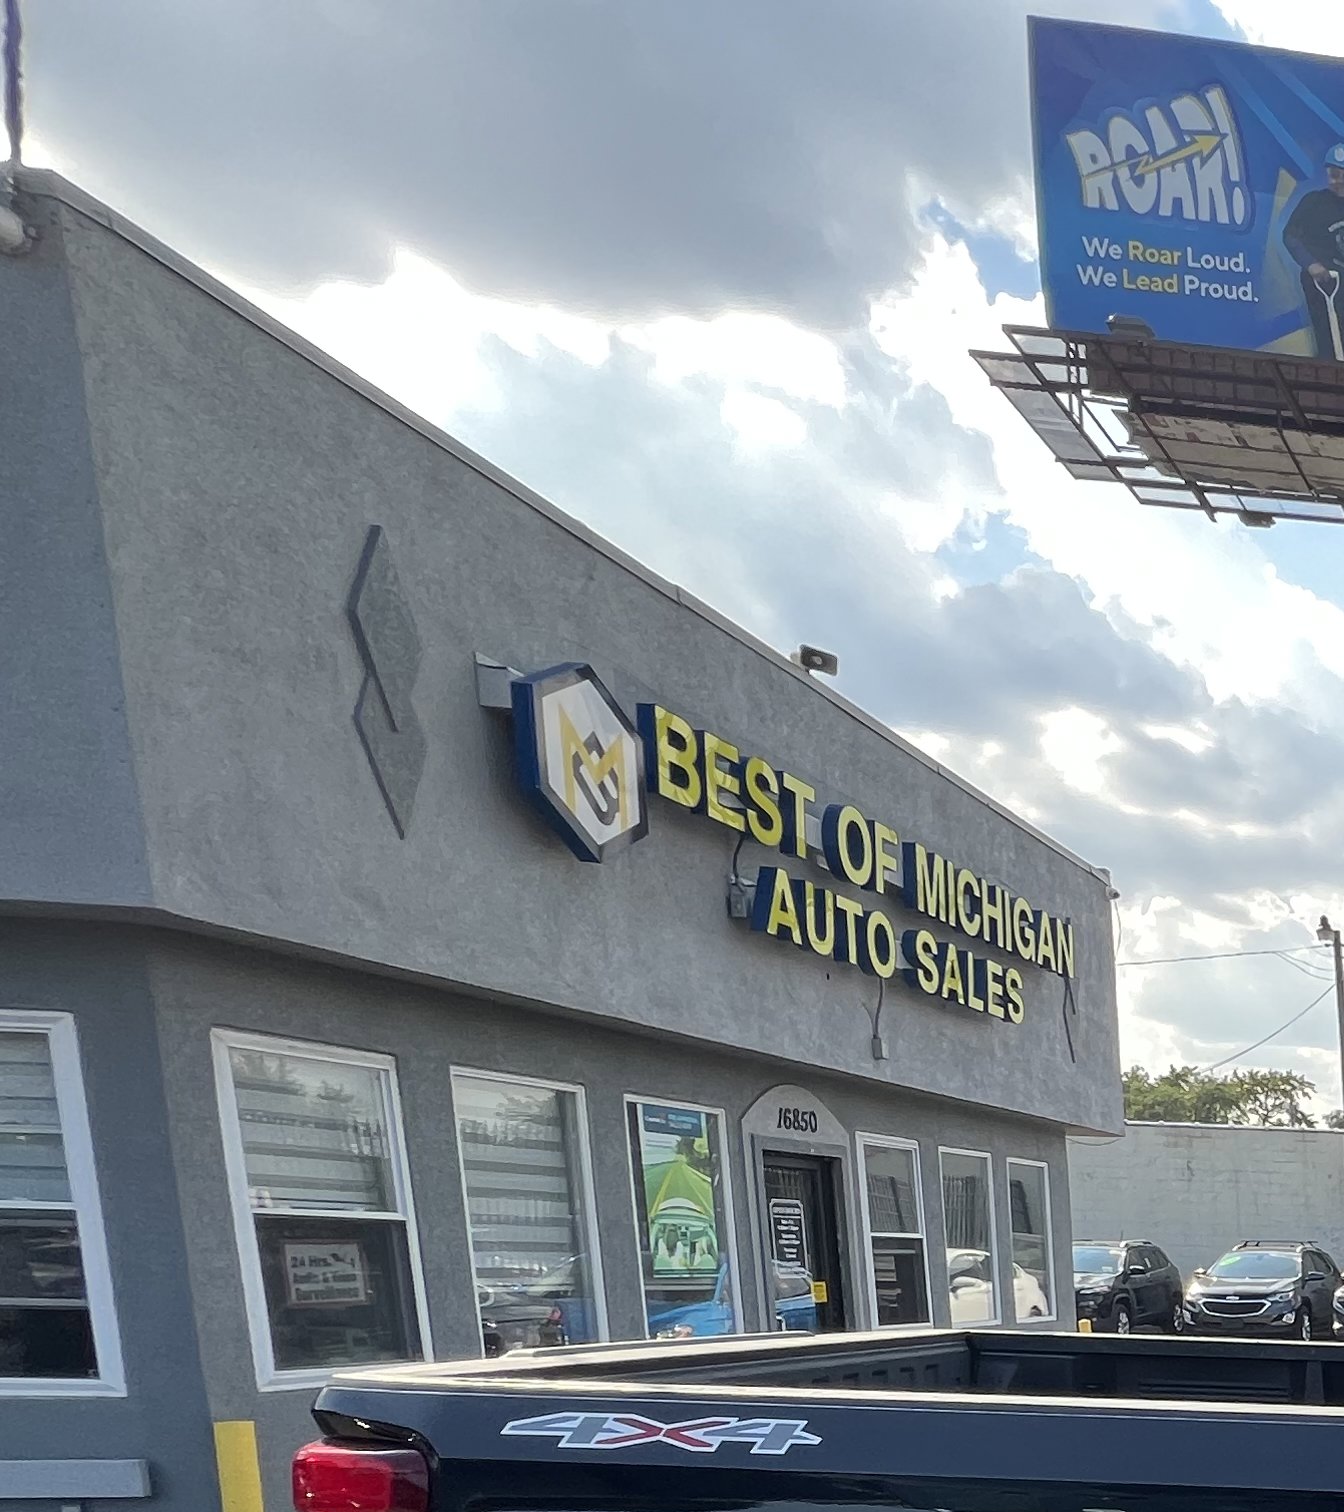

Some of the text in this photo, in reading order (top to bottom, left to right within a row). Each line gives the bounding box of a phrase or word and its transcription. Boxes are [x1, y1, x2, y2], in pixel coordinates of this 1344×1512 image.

[1066, 86, 1246, 225] ROAR!
[1076, 264, 1259, 303] We Lead Proud.
[1081, 235, 1251, 274] We Roar Loud.
[651, 703, 816, 859] BEST
[830, 804, 898, 894] OF
[912, 842, 1074, 978] MICHIGAN
[763, 867, 1026, 1026] AUTO SALES
[777, 1107, 817, 1133] 16850
